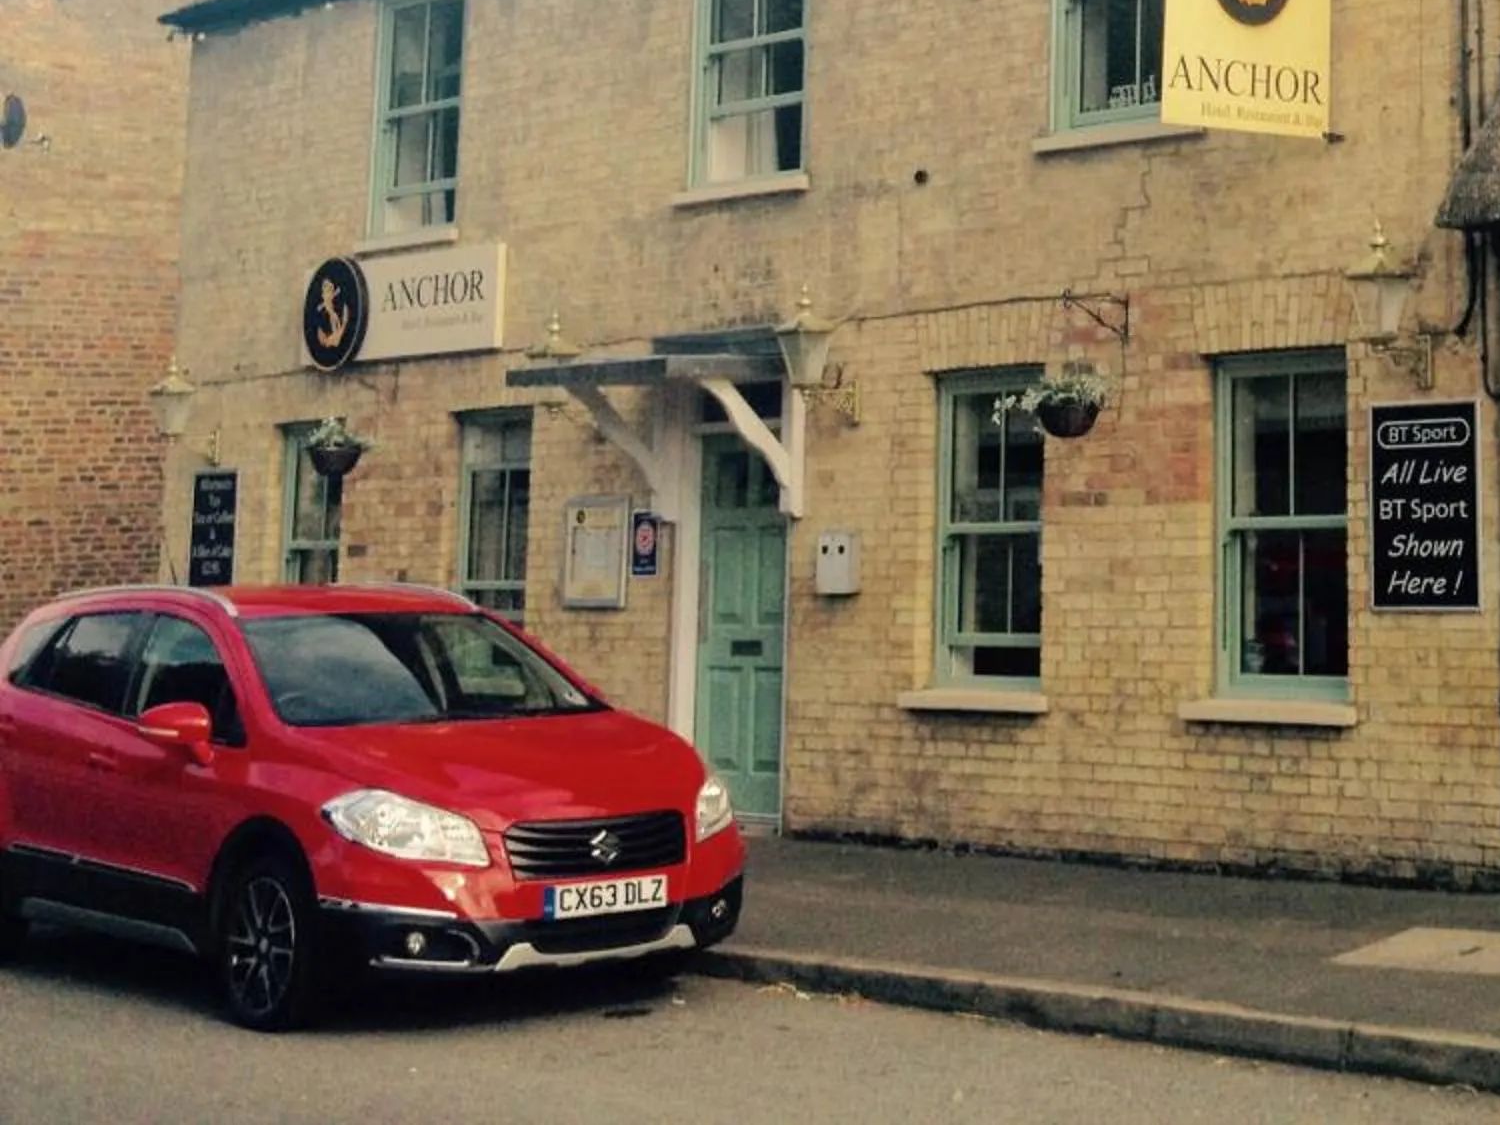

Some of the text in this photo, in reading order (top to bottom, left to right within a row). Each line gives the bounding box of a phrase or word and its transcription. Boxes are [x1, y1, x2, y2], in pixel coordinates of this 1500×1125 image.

[1168, 54, 1324, 105] ANCHOR
[381, 269, 485, 312] ANCHOR
[1388, 425, 1457, 444] BT Sport
[1380, 459, 1468, 484] All Live
[1379, 498, 1468, 523] BT Sport
[1387, 532, 1464, 557] Shown
[1387, 570, 1447, 595] Here
[559, 878, 663, 912] CX63 DLZ
